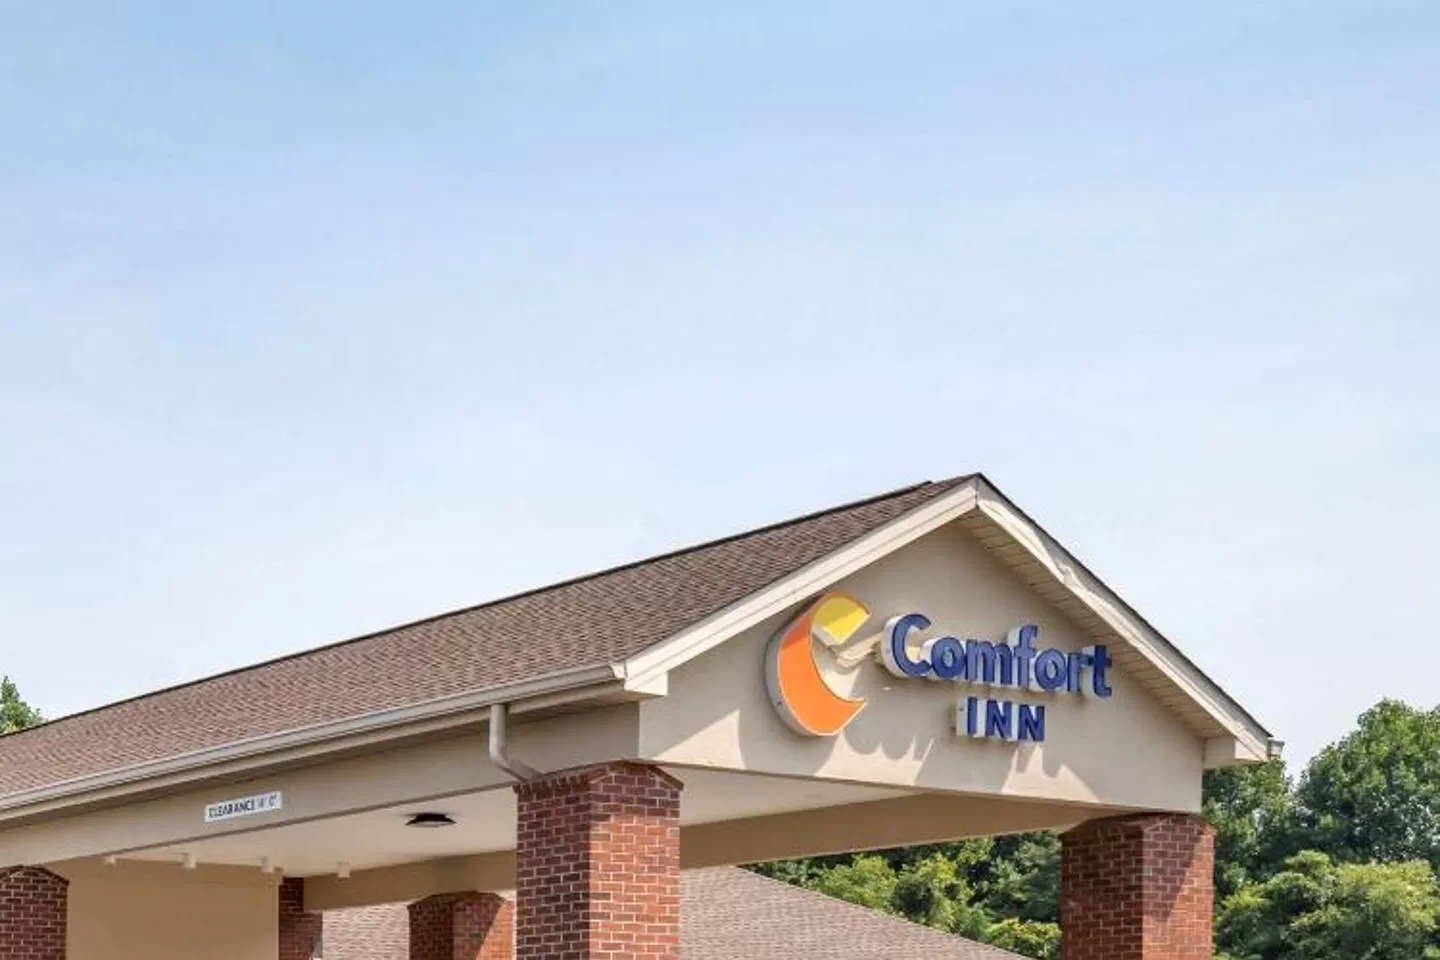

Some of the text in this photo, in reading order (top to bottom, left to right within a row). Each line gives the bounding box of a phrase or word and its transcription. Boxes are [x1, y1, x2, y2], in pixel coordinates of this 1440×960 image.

[888, 612, 1113, 698] Comfort
[966, 696, 1046, 742] INN
[208, 799, 255, 818] CLEARANCE
